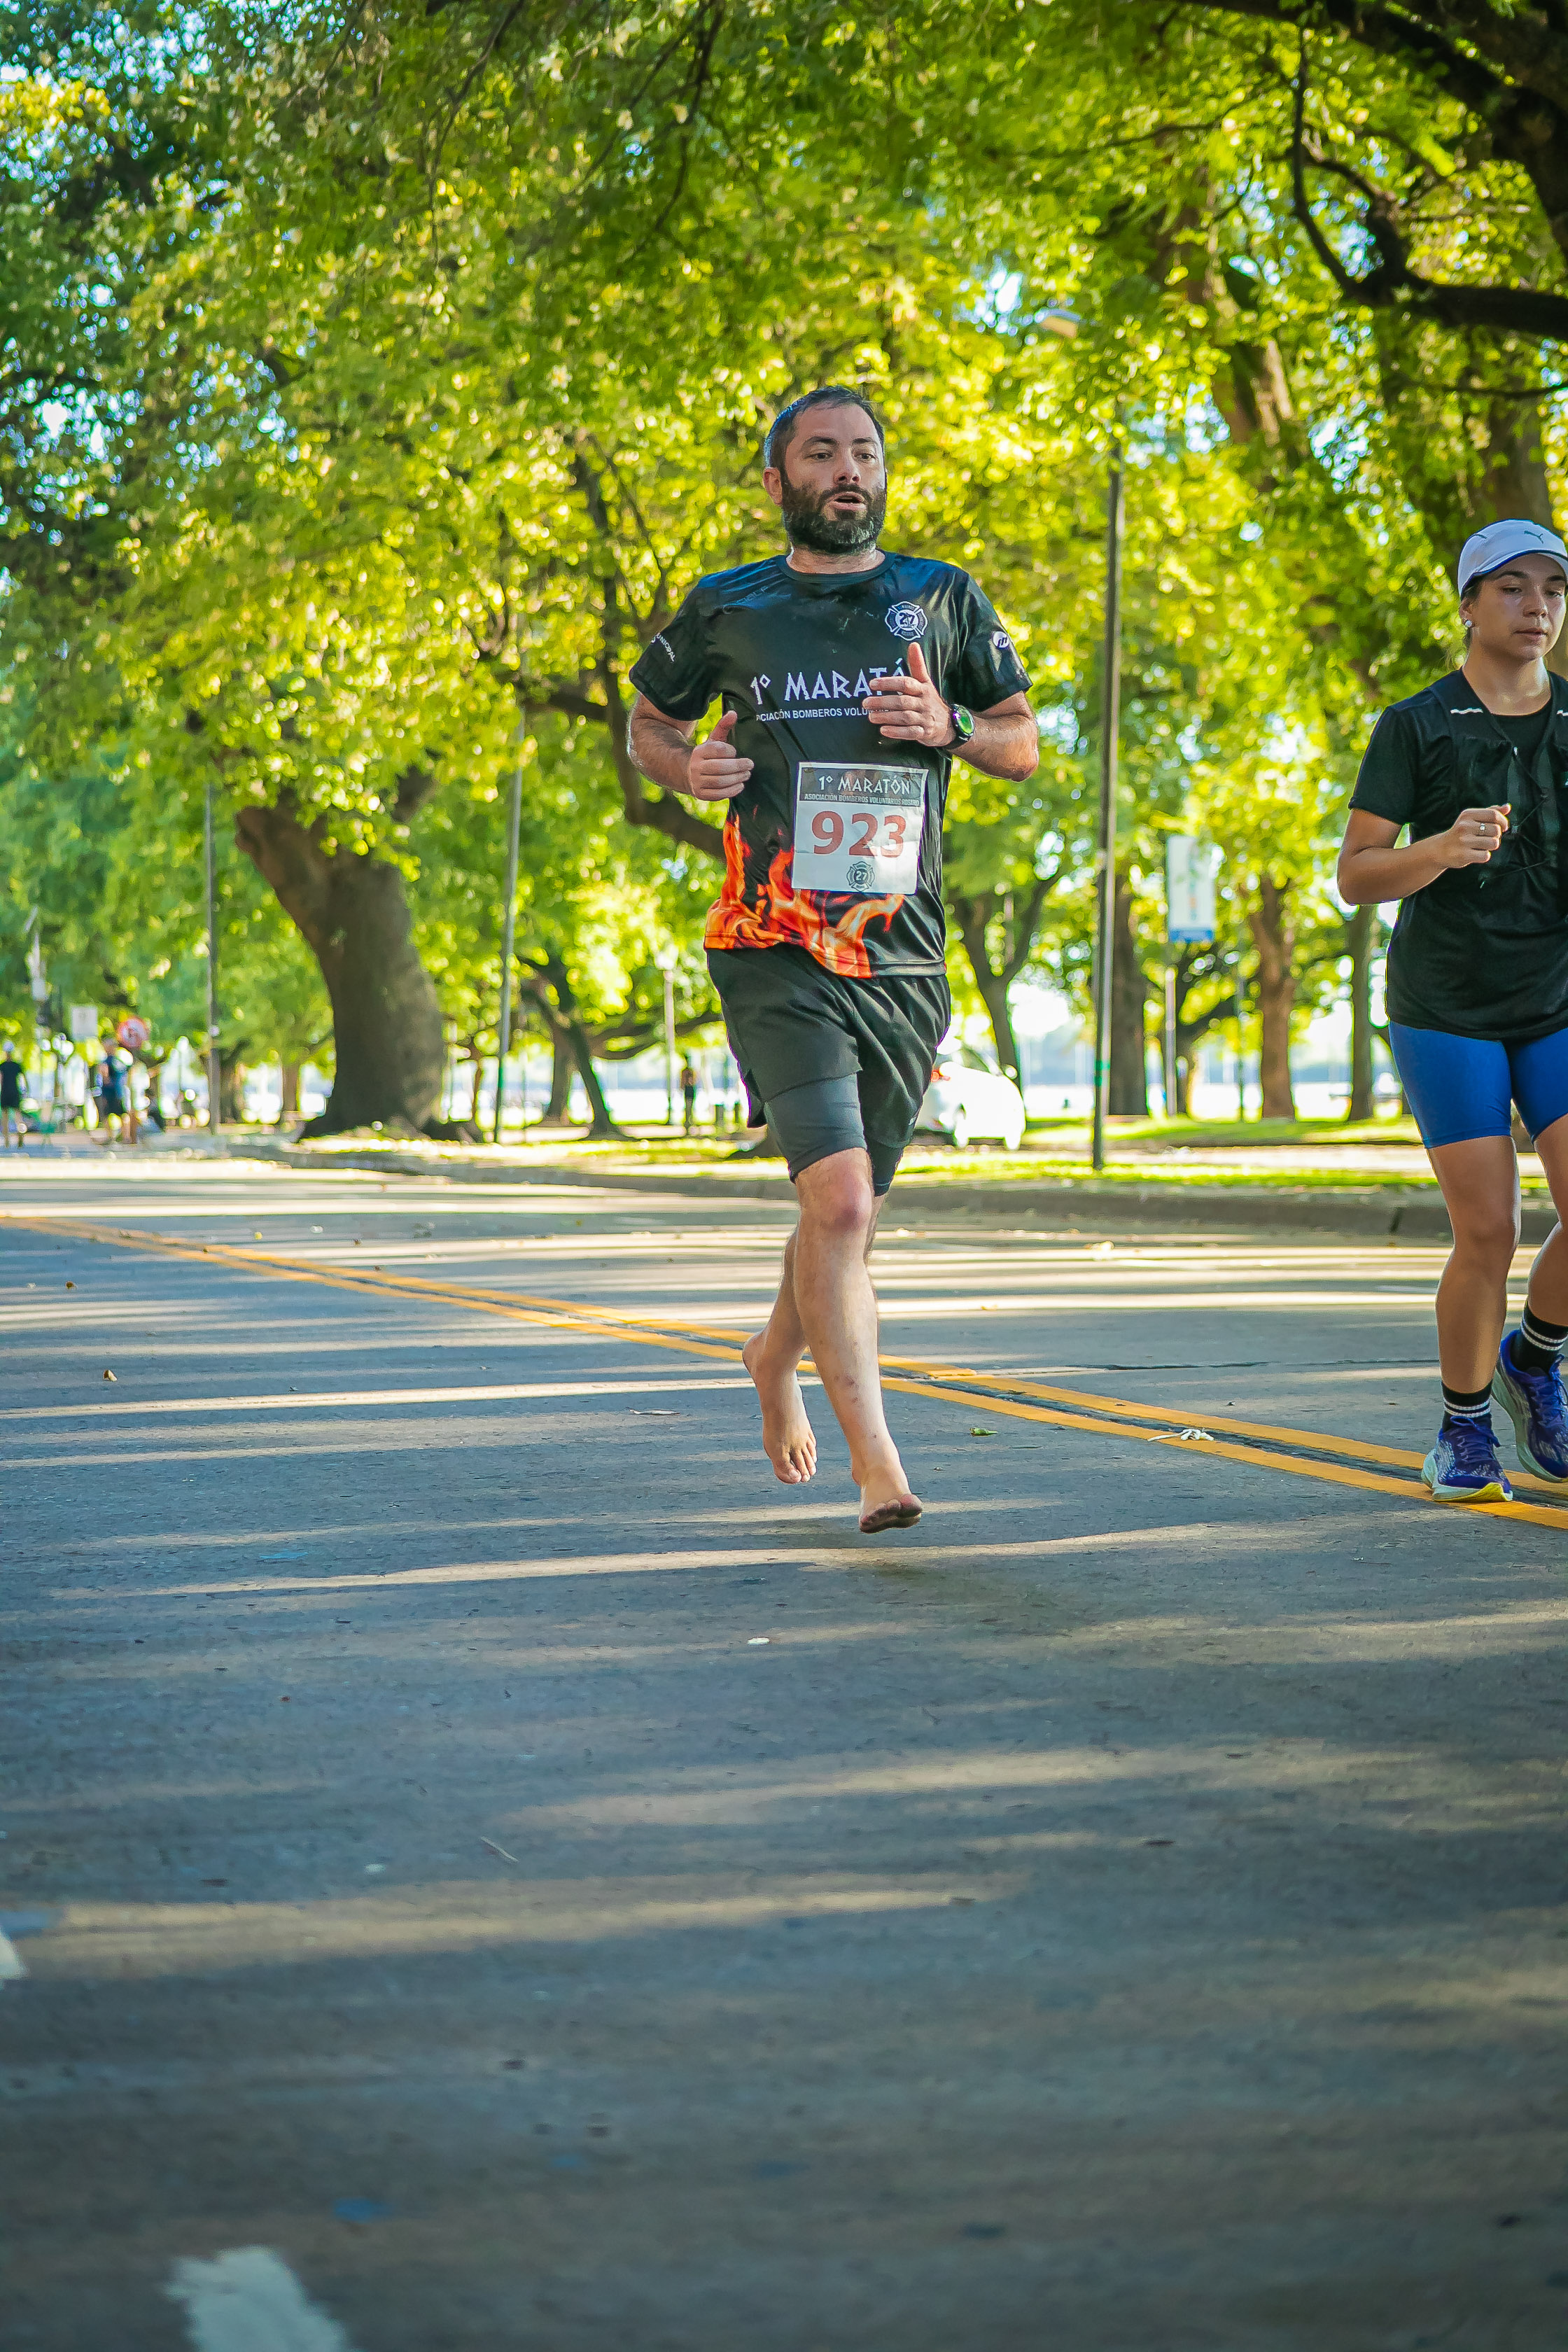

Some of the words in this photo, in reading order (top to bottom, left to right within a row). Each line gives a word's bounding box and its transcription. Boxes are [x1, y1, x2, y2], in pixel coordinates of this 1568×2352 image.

[899, 612, 915, 624] 27
[792, 708, 842, 719] BOMBEROS
[838, 775, 910, 795] MARATÓN
[839, 794, 869, 803] BOMBEROS
[869, 797, 902, 805] VOLUNTARIOS
[811, 810, 906, 858] 923
[855, 870, 867, 881] 27
